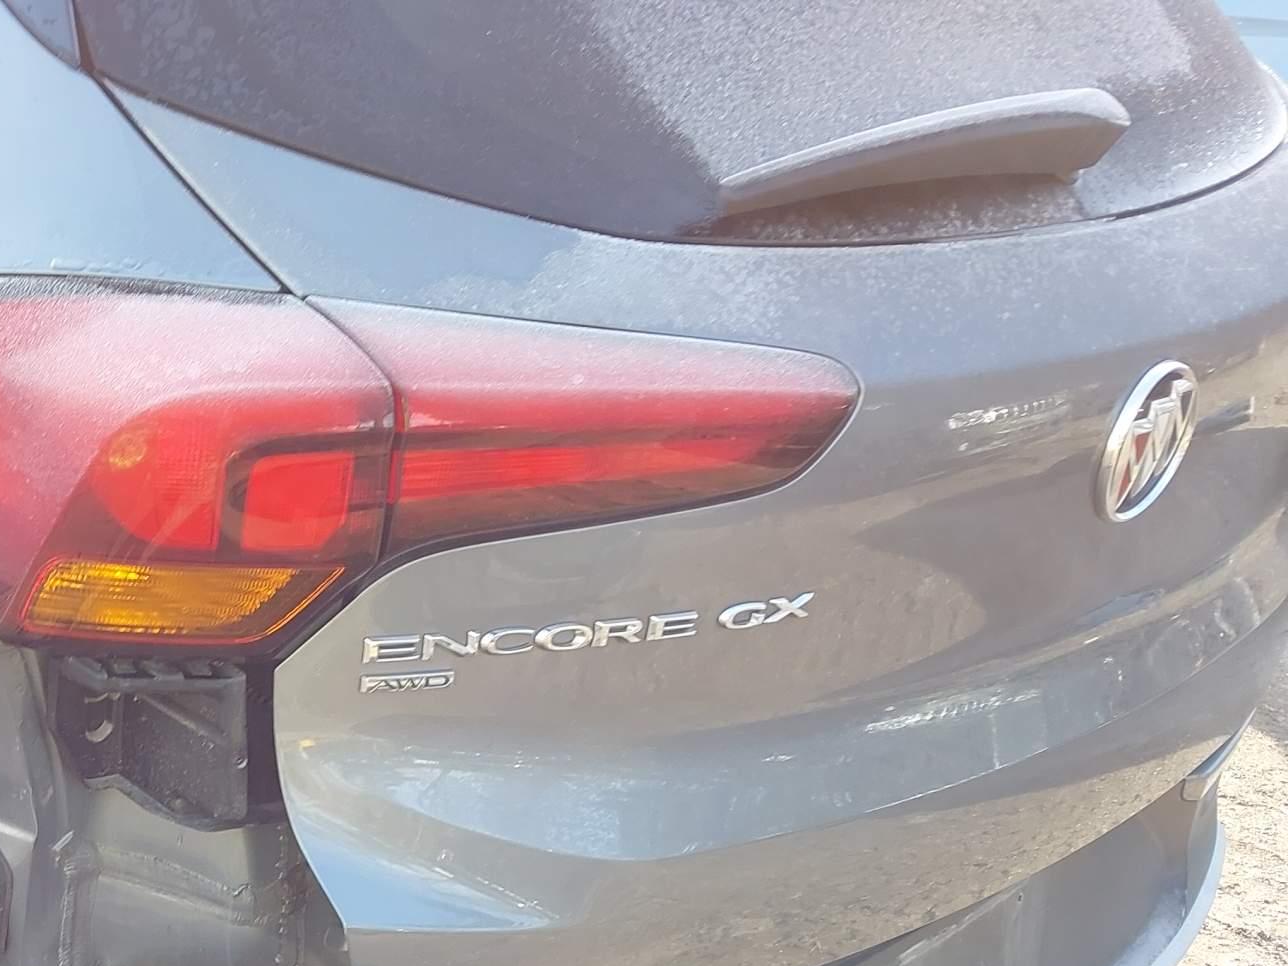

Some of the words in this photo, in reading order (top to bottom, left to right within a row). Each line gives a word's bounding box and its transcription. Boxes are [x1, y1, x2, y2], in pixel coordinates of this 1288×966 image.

[361, 609, 699, 665] ENCORE
[716, 591, 815, 631] GX
[364, 672, 454, 694] AWD
